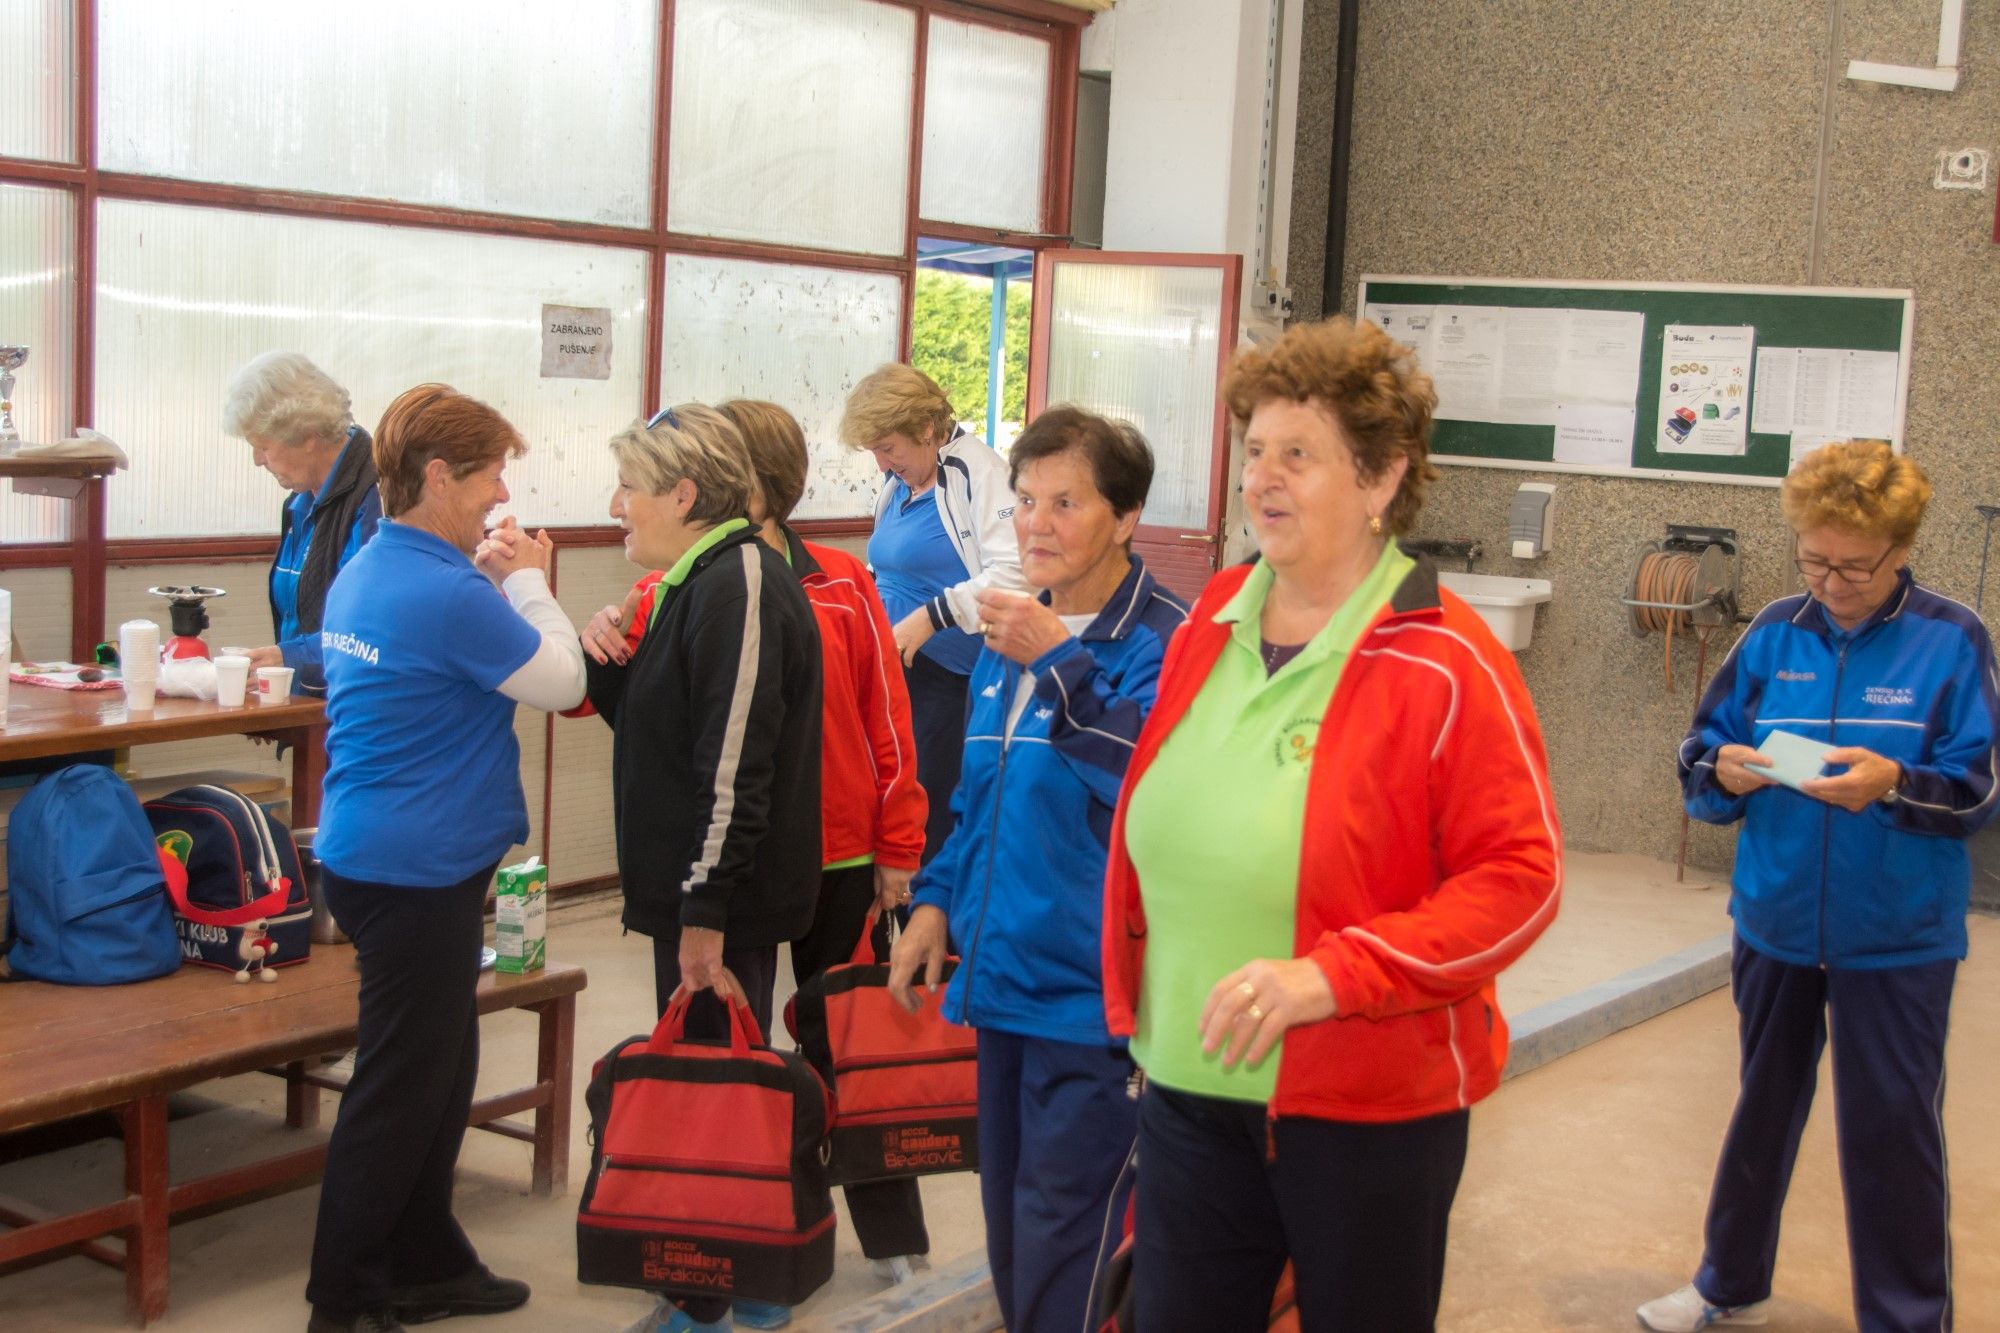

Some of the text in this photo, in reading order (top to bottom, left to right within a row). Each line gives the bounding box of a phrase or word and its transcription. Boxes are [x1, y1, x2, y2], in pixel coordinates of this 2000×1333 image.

[550, 324, 603, 336] ZABRANJENO
[559, 343, 596, 355] PUŠENJE
[190, 922, 229, 944] KLUB
